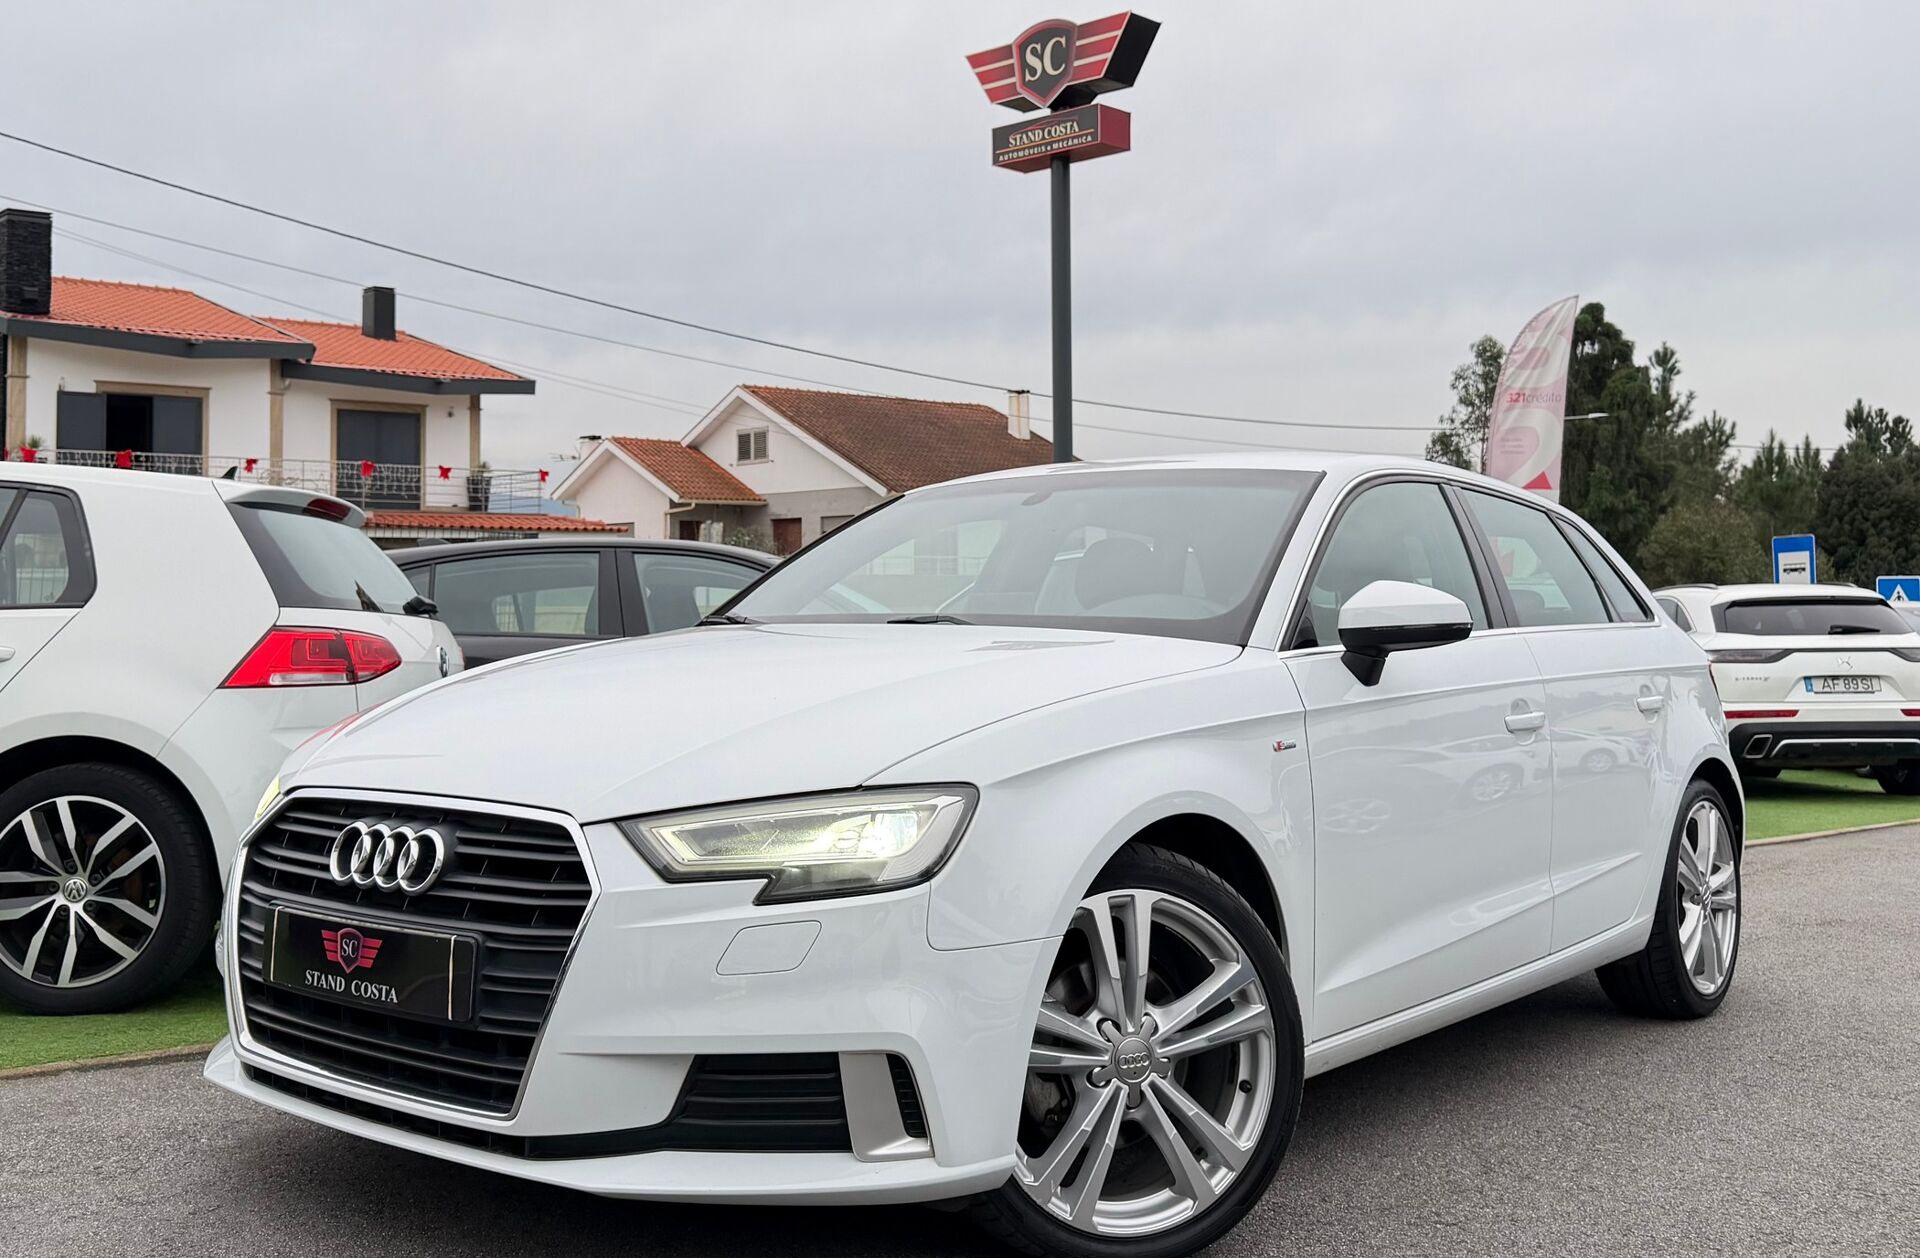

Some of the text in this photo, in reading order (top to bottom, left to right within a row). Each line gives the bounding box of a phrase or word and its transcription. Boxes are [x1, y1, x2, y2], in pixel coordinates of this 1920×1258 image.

[1025, 36, 1066, 82] SC
[1009, 121, 1080, 148] STAND COSTA
[999, 144, 1046, 161] AUTOMÓVEIS
[1052, 135, 1092, 149] MECÂNICA
[1822, 677, 1874, 691] AF 89 SI
[341, 938, 358, 958] SC
[305, 969, 399, 1003] STAND COSTA
